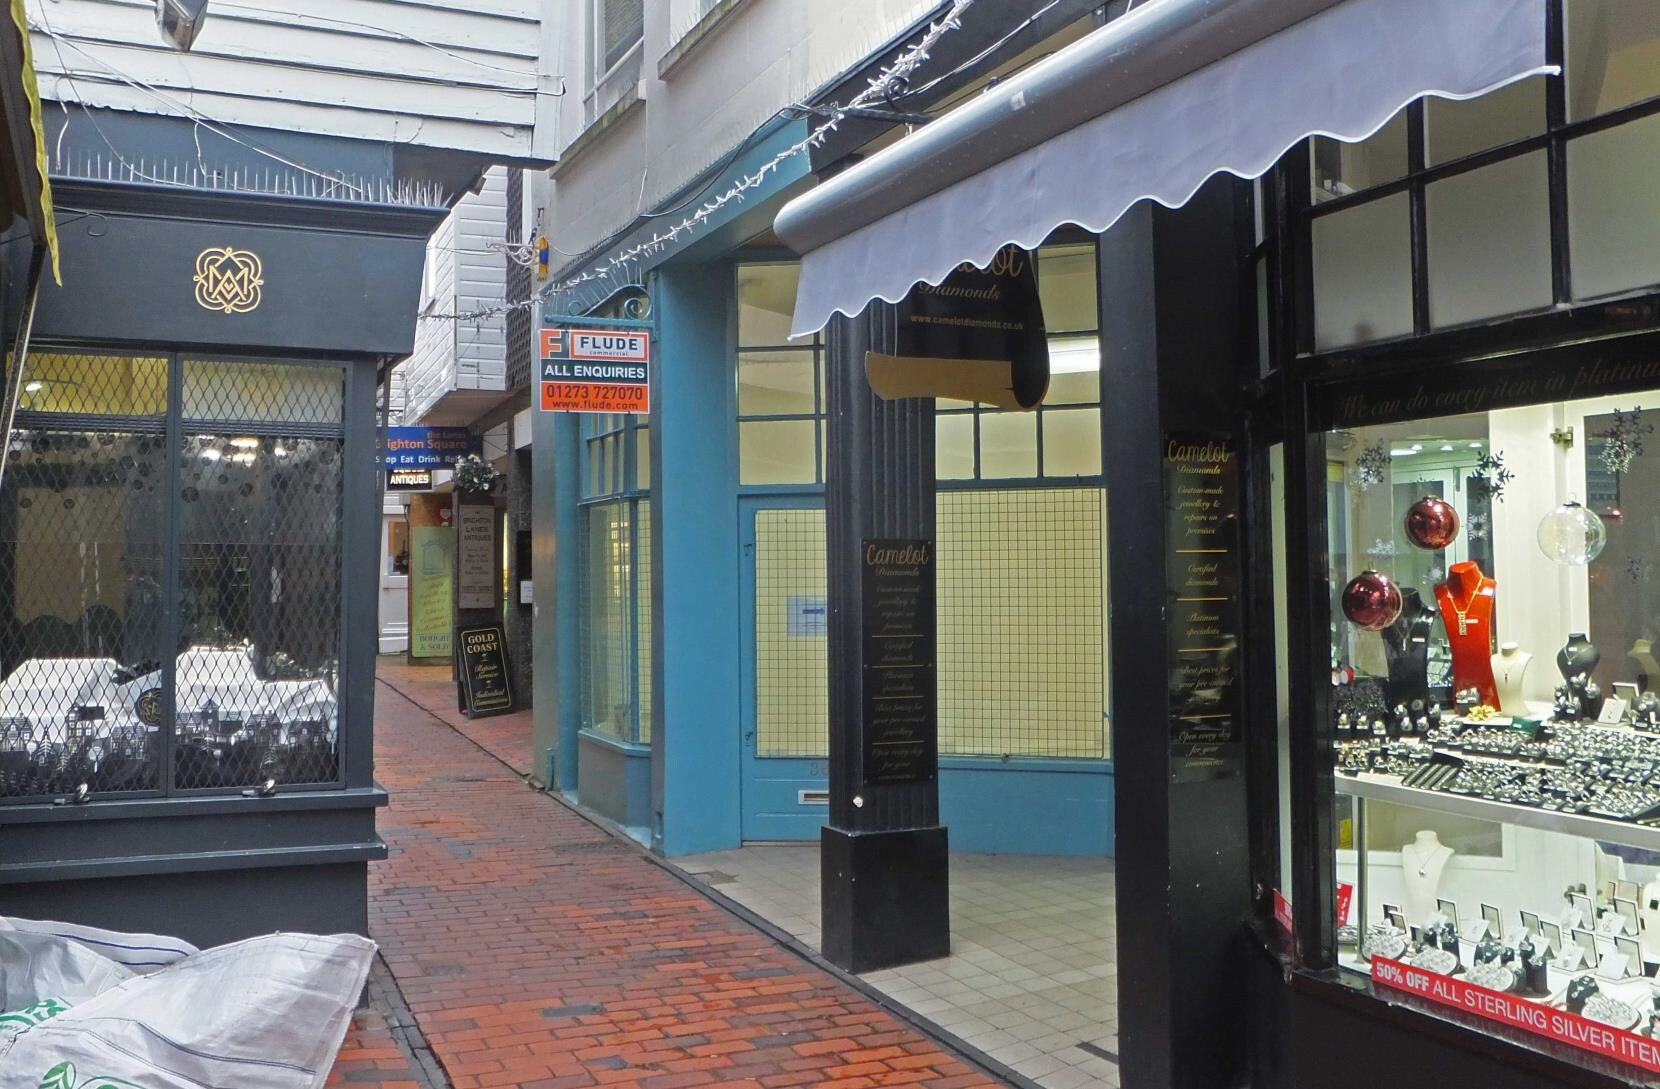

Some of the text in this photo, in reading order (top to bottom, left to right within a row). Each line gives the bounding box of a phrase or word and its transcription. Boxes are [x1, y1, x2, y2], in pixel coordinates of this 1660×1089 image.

[917, 281, 1000, 300] Diamonds
[910, 314, 1024, 330] www.camelotdiamonds.co.uk
[580, 336, 638, 351] FLUDE
[544, 364, 645, 379] ALL ENQUIRIES
[546, 384, 643, 401] 01273 727070
[1341, 359, 1660, 418] We can do every item in platinu
[552, 400, 638, 411] www.flude.com
[427, 439, 467, 451] Square
[1168, 439, 1233, 463] Camelot
[400, 455, 414, 464] Eat
[418, 455, 441, 464] Drink
[1176, 464, 1221, 475] Diamonds
[390, 474, 429, 485] ANTIQUES
[866, 543, 929, 566] Camelot
[468, 633, 495, 644] GOLD
[467, 642, 498, 654] COAST
[1376, 961, 1403, 985] 50%
[1406, 971, 1430, 992] OFF
[1432, 980, 1462, 1003] ALL
[1464, 989, 1547, 1029] STERLING
[1551, 1015, 1616, 1051] SILVER
